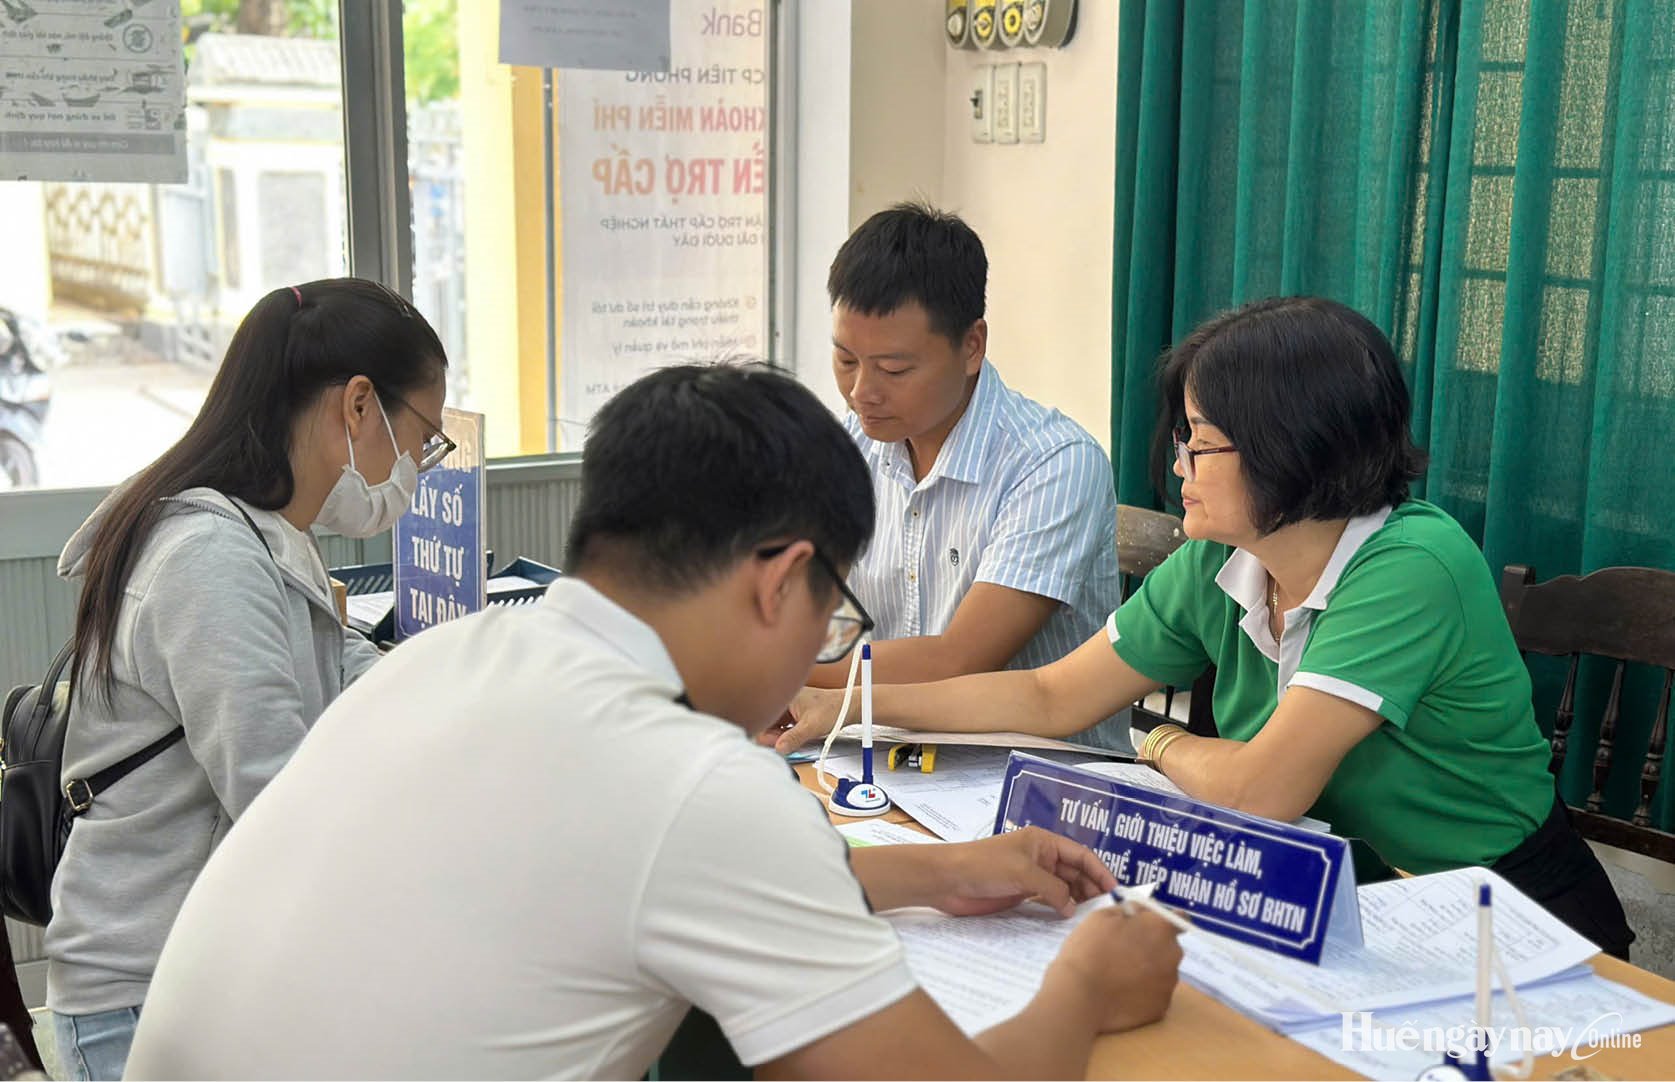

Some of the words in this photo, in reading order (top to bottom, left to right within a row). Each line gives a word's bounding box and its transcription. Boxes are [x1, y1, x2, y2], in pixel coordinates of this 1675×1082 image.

[411, 475, 438, 519] LẤY
[441, 483, 463, 527] SỐ
[411, 535, 441, 573] THỨ
[442, 544, 464, 587] TỰ
[409, 587, 433, 629] TẠI
[1060, 797, 1082, 823] TƯ
[1080, 799, 1111, 837] VẤN,
[1113, 812, 1146, 843] GIỚI
[1146, 821, 1190, 857] THIỆU
[1190, 832, 1225, 868] VIỆC
[1225, 841, 1264, 880] LÀM,
[1135, 857, 1168, 891] TIẾP
[1167, 870, 1212, 907] NHẬN
[1211, 878, 1239, 912] HỒ
[1237, 889, 1263, 919] SƠ
[1260, 896, 1307, 934] BHTN
